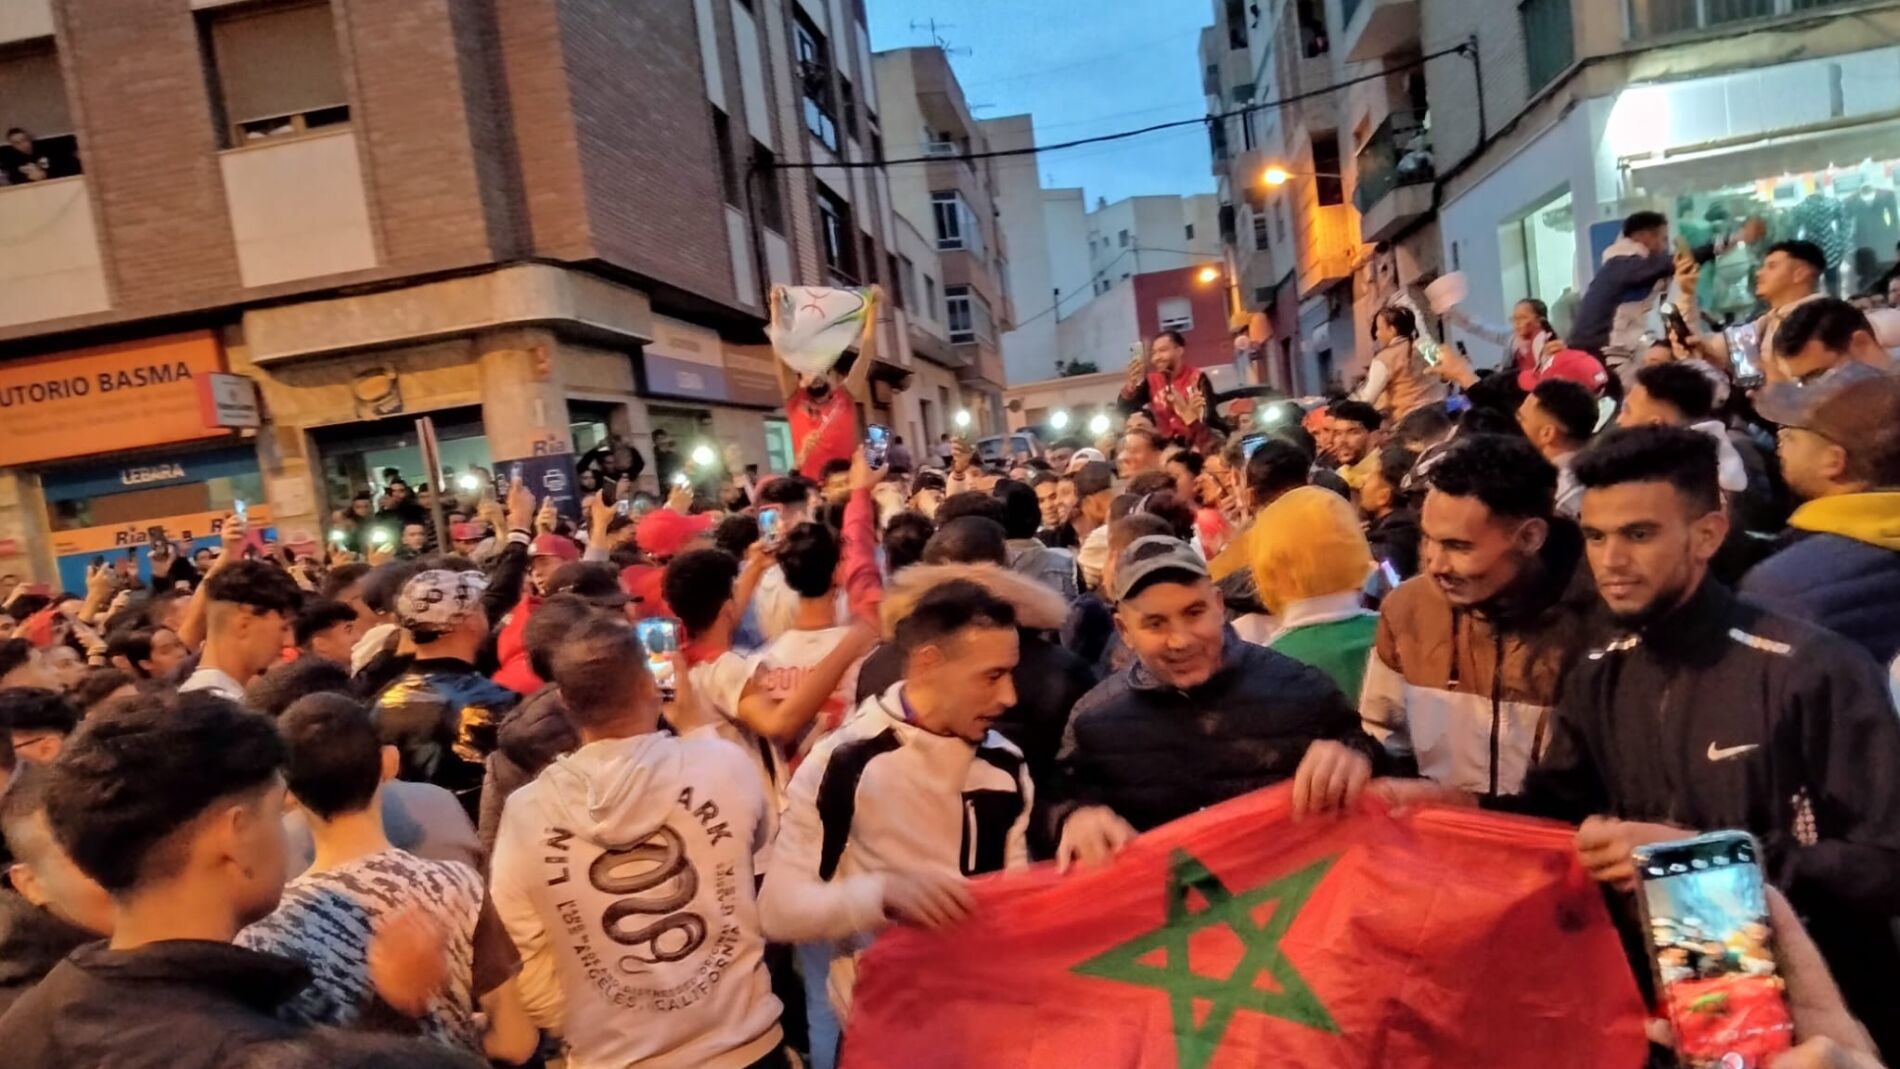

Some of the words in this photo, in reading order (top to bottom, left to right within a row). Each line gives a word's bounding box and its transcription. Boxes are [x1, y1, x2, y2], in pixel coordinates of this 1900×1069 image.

[0, 377, 90, 407] UTORIO
[97, 362, 192, 393] BASMA
[116, 527, 146, 545] Ria
[677, 786, 734, 848] ARK
[655, 926, 741, 1012] CALIFORNIA
